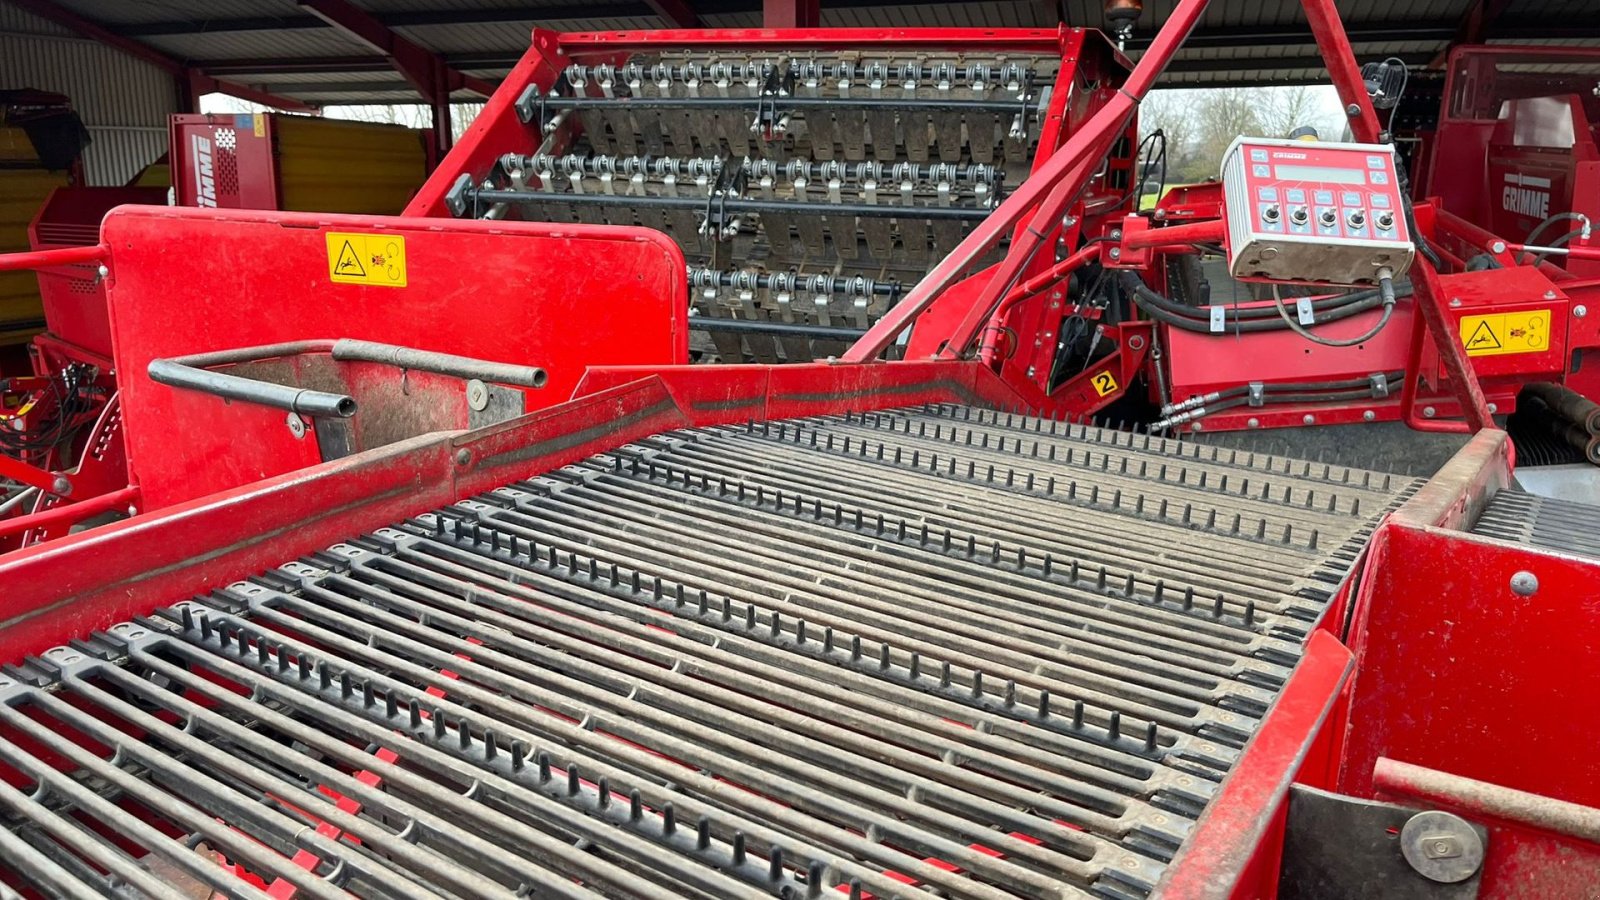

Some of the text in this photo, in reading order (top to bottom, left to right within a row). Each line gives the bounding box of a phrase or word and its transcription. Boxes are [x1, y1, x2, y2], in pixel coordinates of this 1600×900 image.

[197, 135, 217, 208] IMME
[1502, 186, 1550, 220] GRIMME
[1097, 374, 1114, 393] 2
